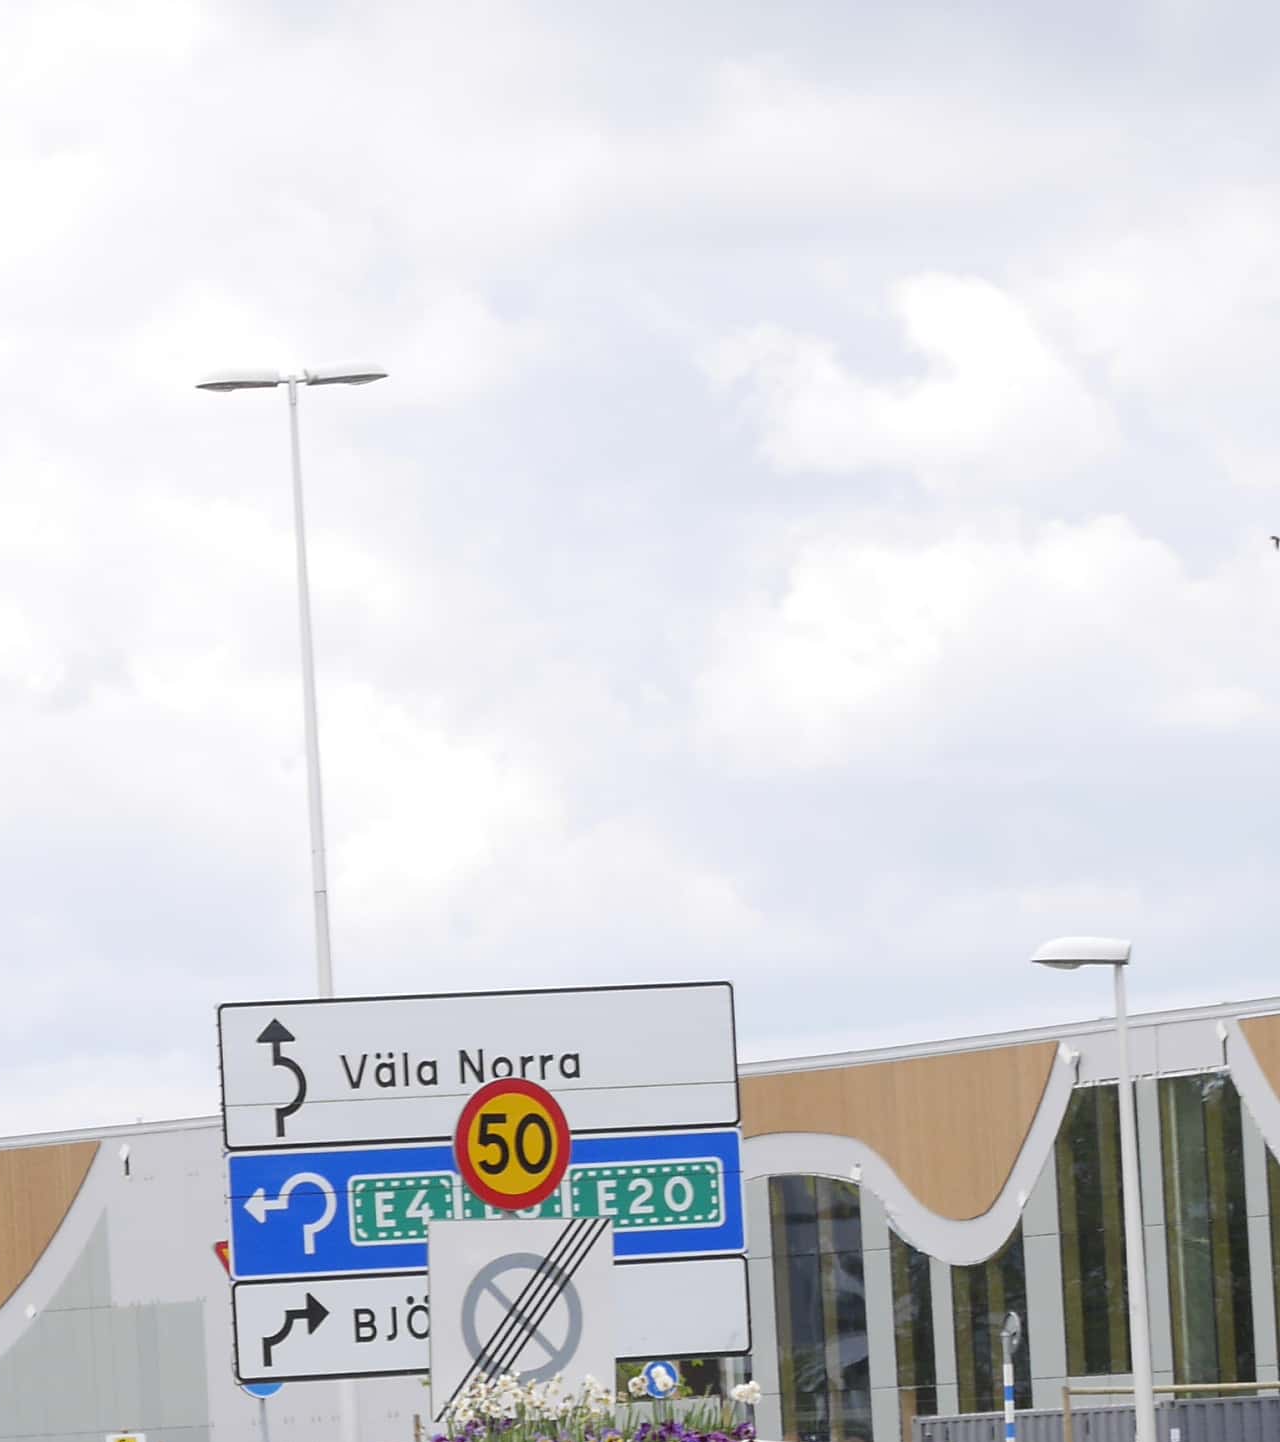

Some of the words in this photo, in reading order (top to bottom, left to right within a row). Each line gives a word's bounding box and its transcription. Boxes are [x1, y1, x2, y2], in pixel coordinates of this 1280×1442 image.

[340, 1052, 439, 1090] Väla
[458, 1048, 581, 1085] Norra
[477, 1113, 553, 1175] 50
[375, 1188, 434, 1228] E4
[596, 1176, 695, 1217] E20
